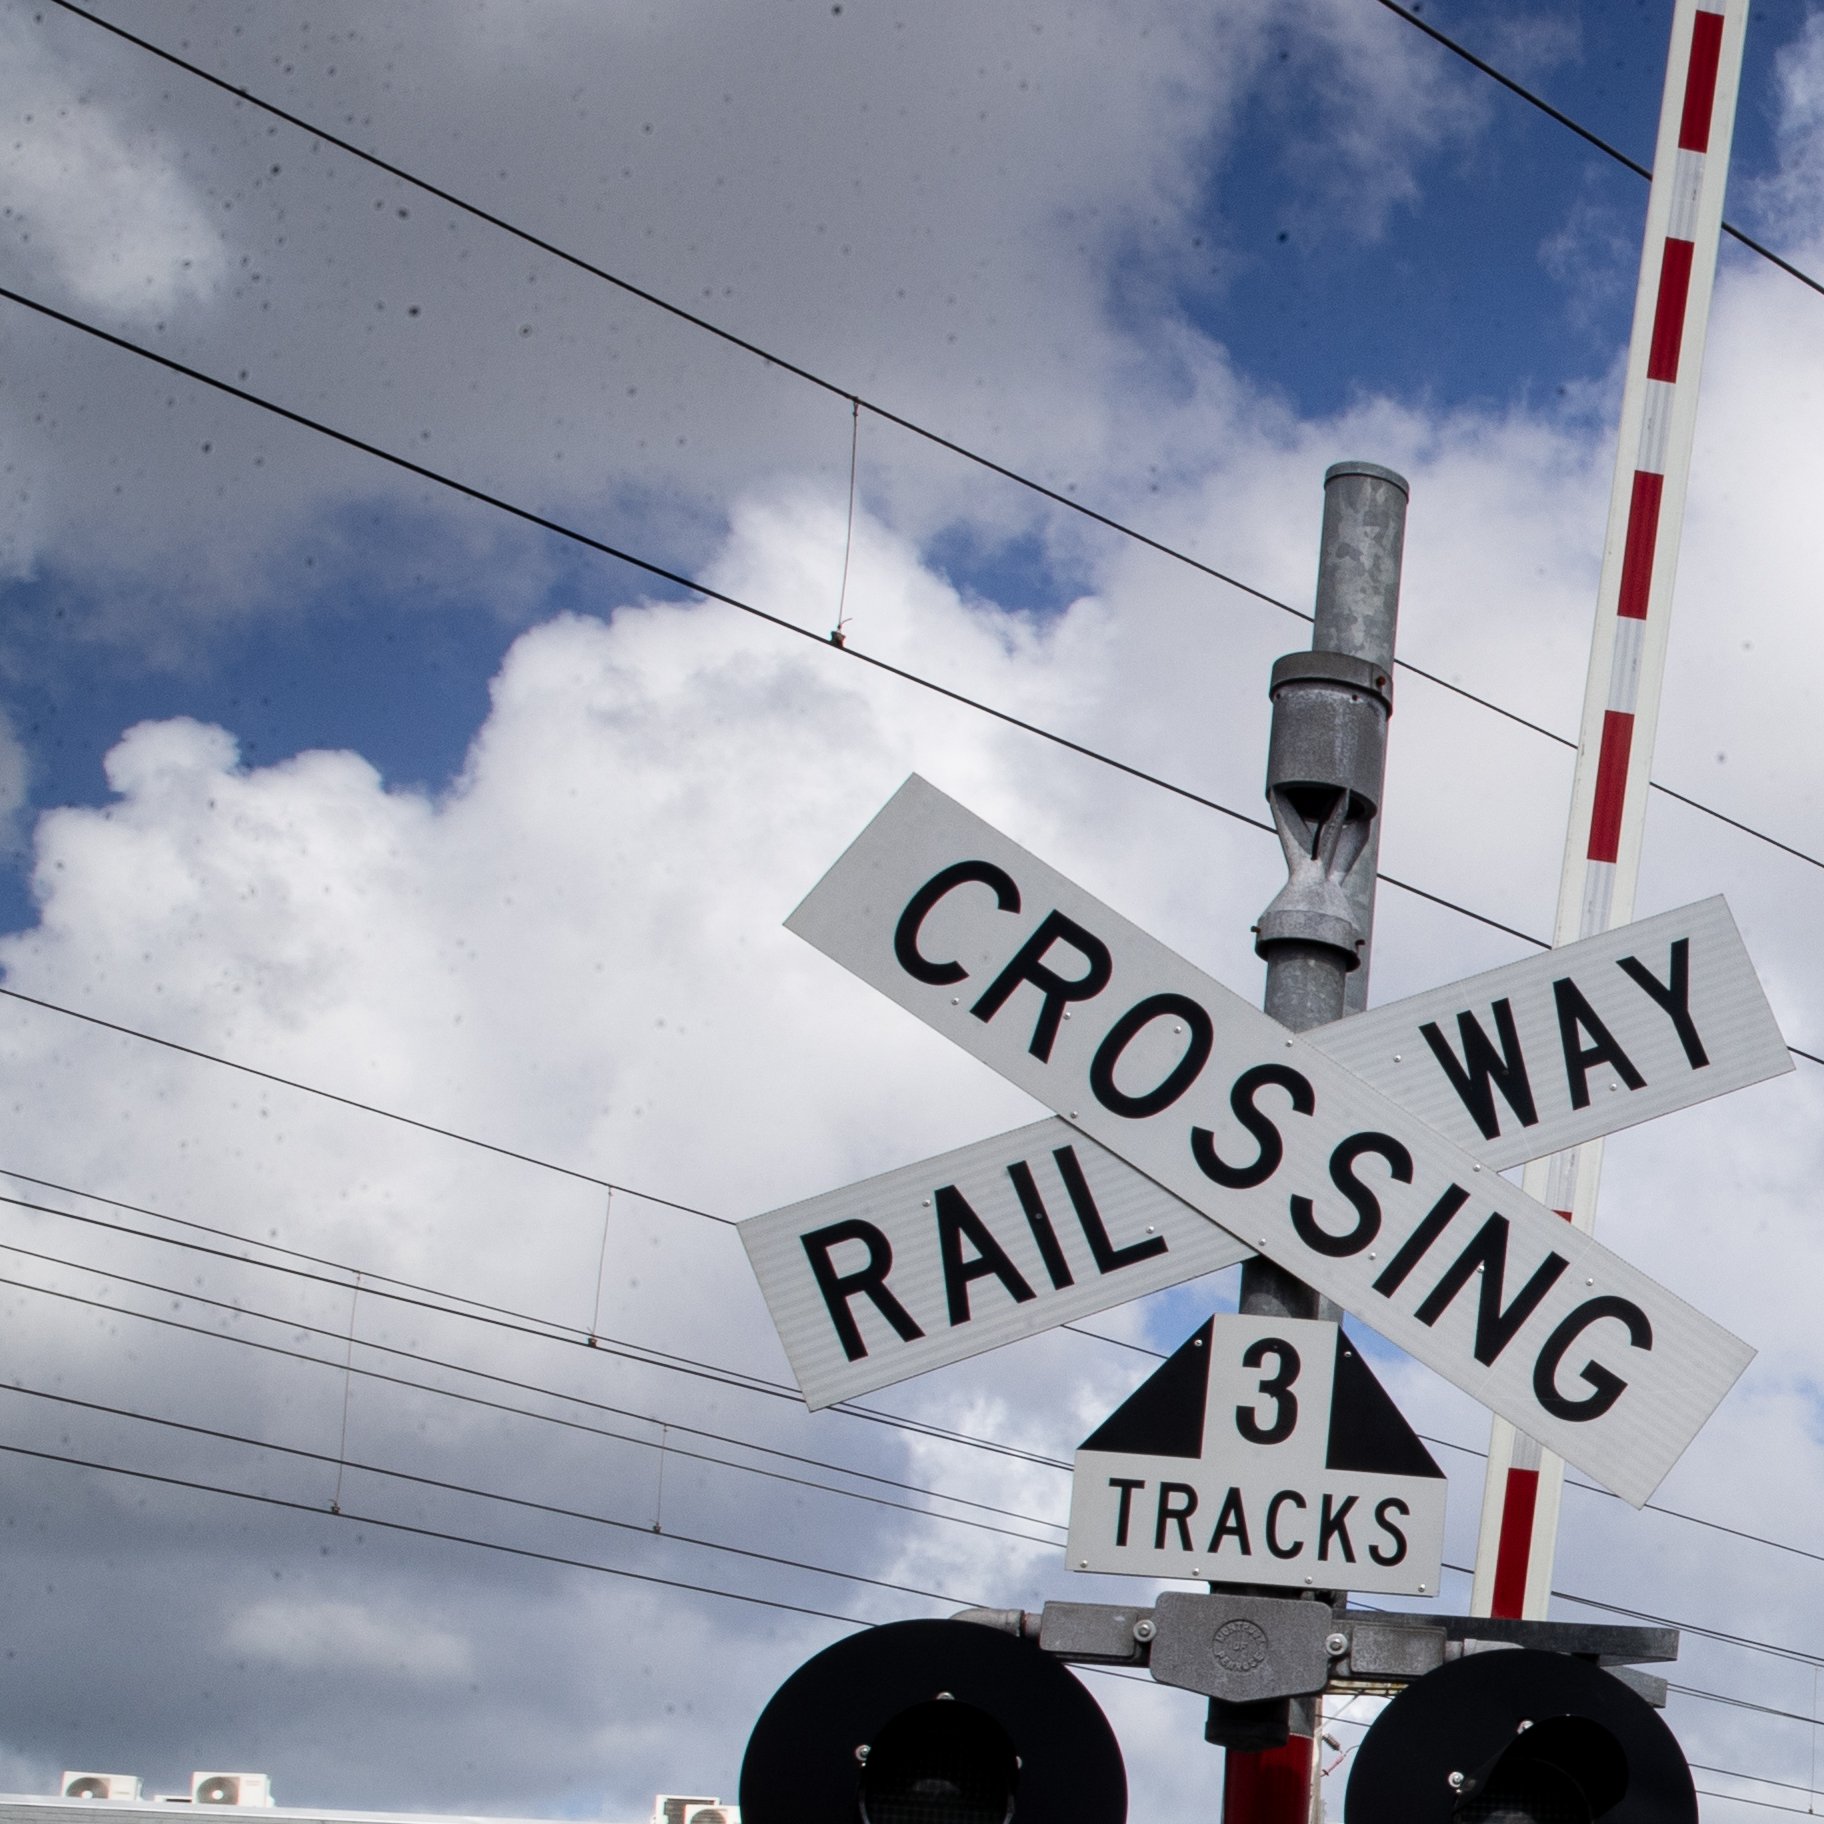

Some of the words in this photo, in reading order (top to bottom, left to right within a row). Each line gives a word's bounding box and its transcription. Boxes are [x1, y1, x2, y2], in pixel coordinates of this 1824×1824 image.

[800, 1143, 1169, 1361] RAIL
[1418, 937, 1711, 1140] WAY
[893, 860, 1654, 1422] CROSSING
[1108, 1477, 1410, 1566] TRACKS
[1235, 1337, 1301, 1445] 3
